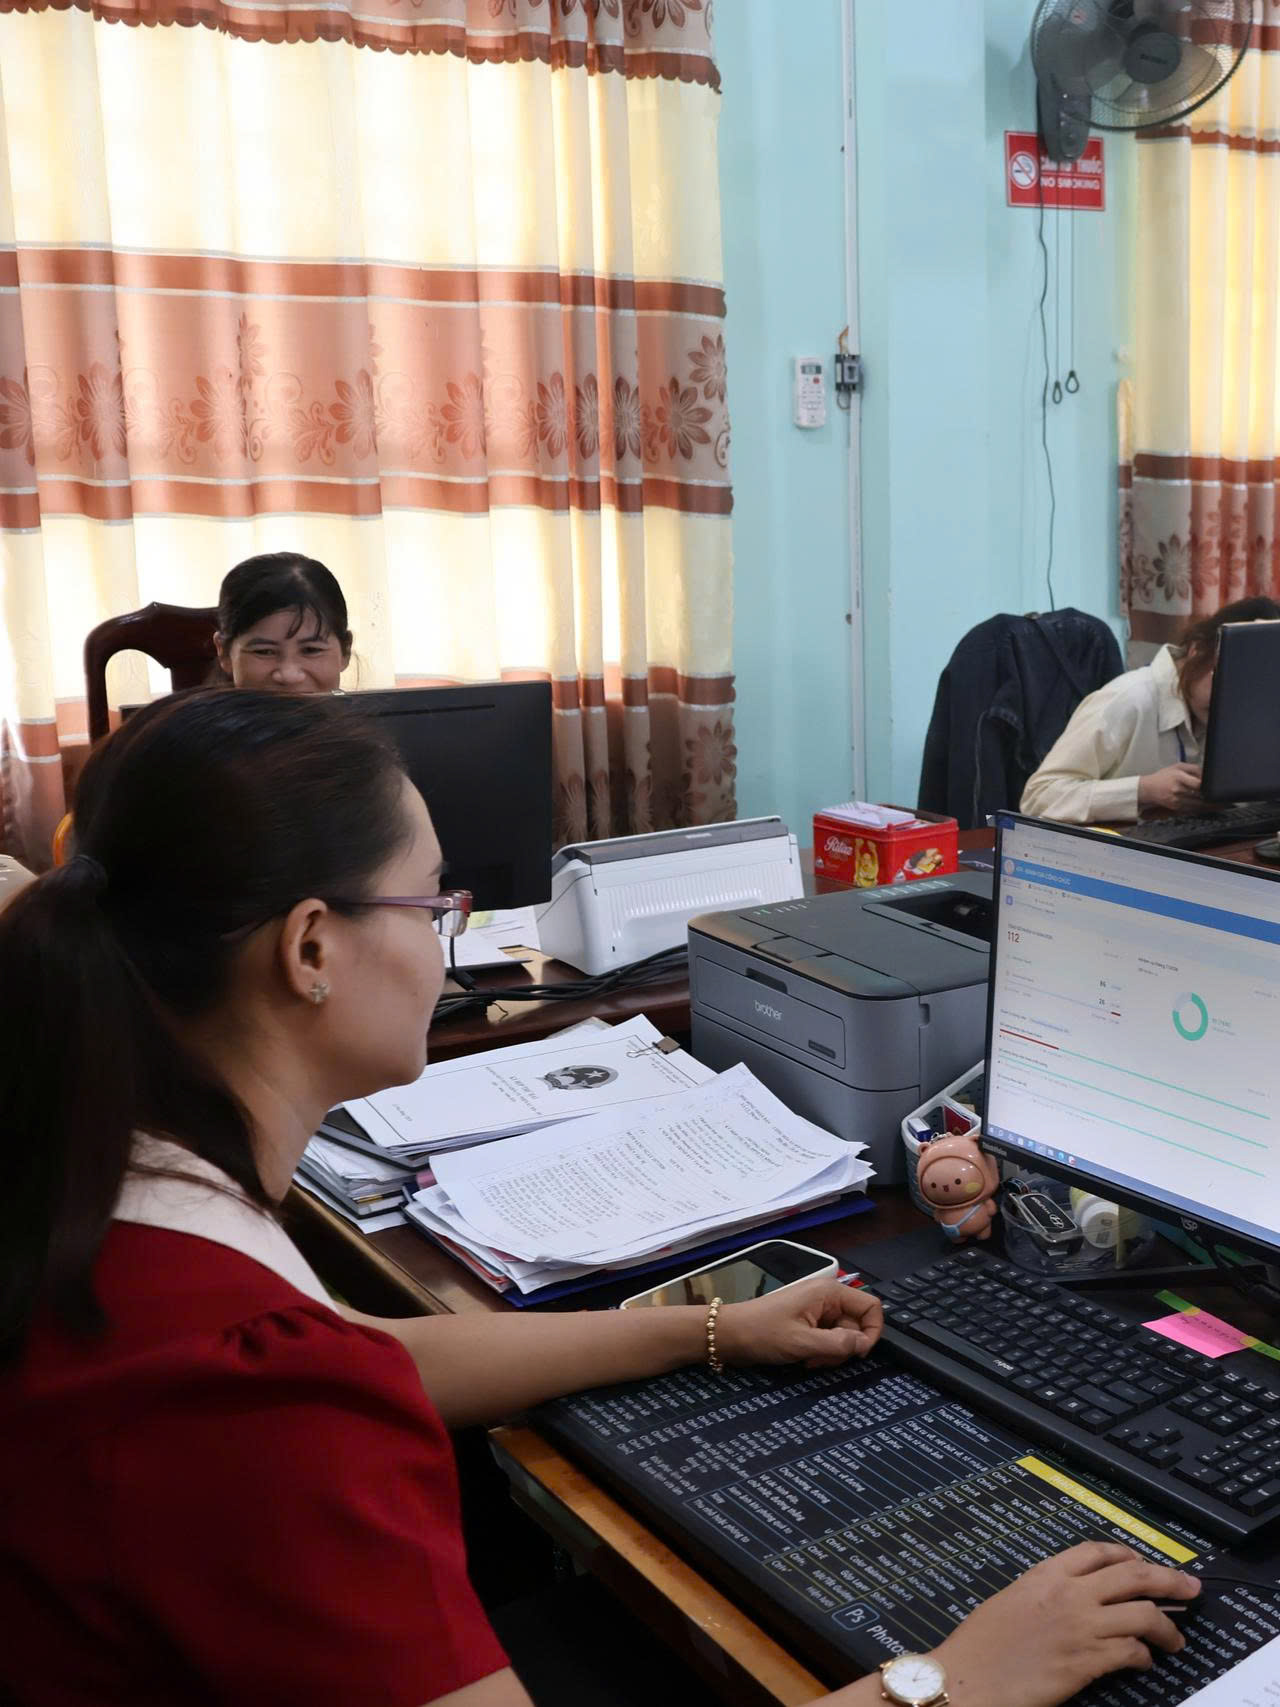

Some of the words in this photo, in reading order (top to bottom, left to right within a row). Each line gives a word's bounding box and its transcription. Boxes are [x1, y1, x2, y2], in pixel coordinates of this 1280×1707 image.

[1041, 177, 1056, 187] NO
[1058, 178, 1100, 190] SMOKING
[1007, 931, 1020, 943] 112
[754, 1000, 783, 1021] brother
[1037, 1499, 1058, 1511] Undo
[1058, 1495, 1074, 1504] Cut
[843, 1607, 870, 1623] Ps
[864, 1623, 914, 1657] Photos
